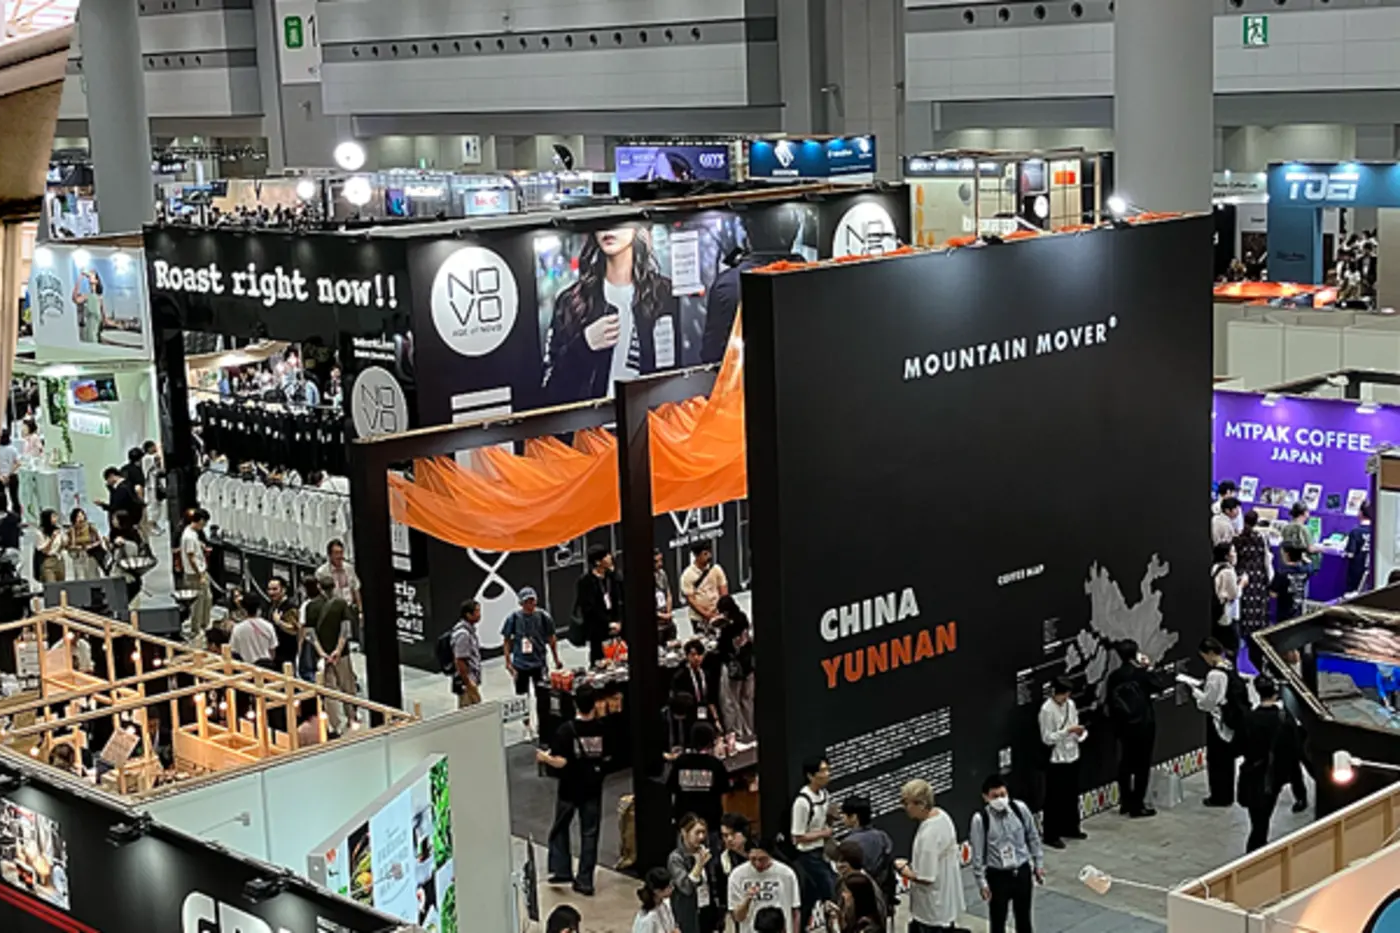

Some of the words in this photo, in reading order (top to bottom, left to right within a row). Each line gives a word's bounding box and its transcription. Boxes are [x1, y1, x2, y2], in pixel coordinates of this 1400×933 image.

[154, 260, 225, 295] Roast
[232, 262, 309, 307] right
[317, 273, 398, 309] now!!
[903, 337, 1027, 380] MOUNTAIN
[1225, 421, 1292, 444] MTPAK
[1294, 427, 1373, 452] COFFEE
[1271, 447, 1324, 465] JAPAN
[820, 587, 920, 642] CHINA
[821, 621, 957, 689] YUNNAN
